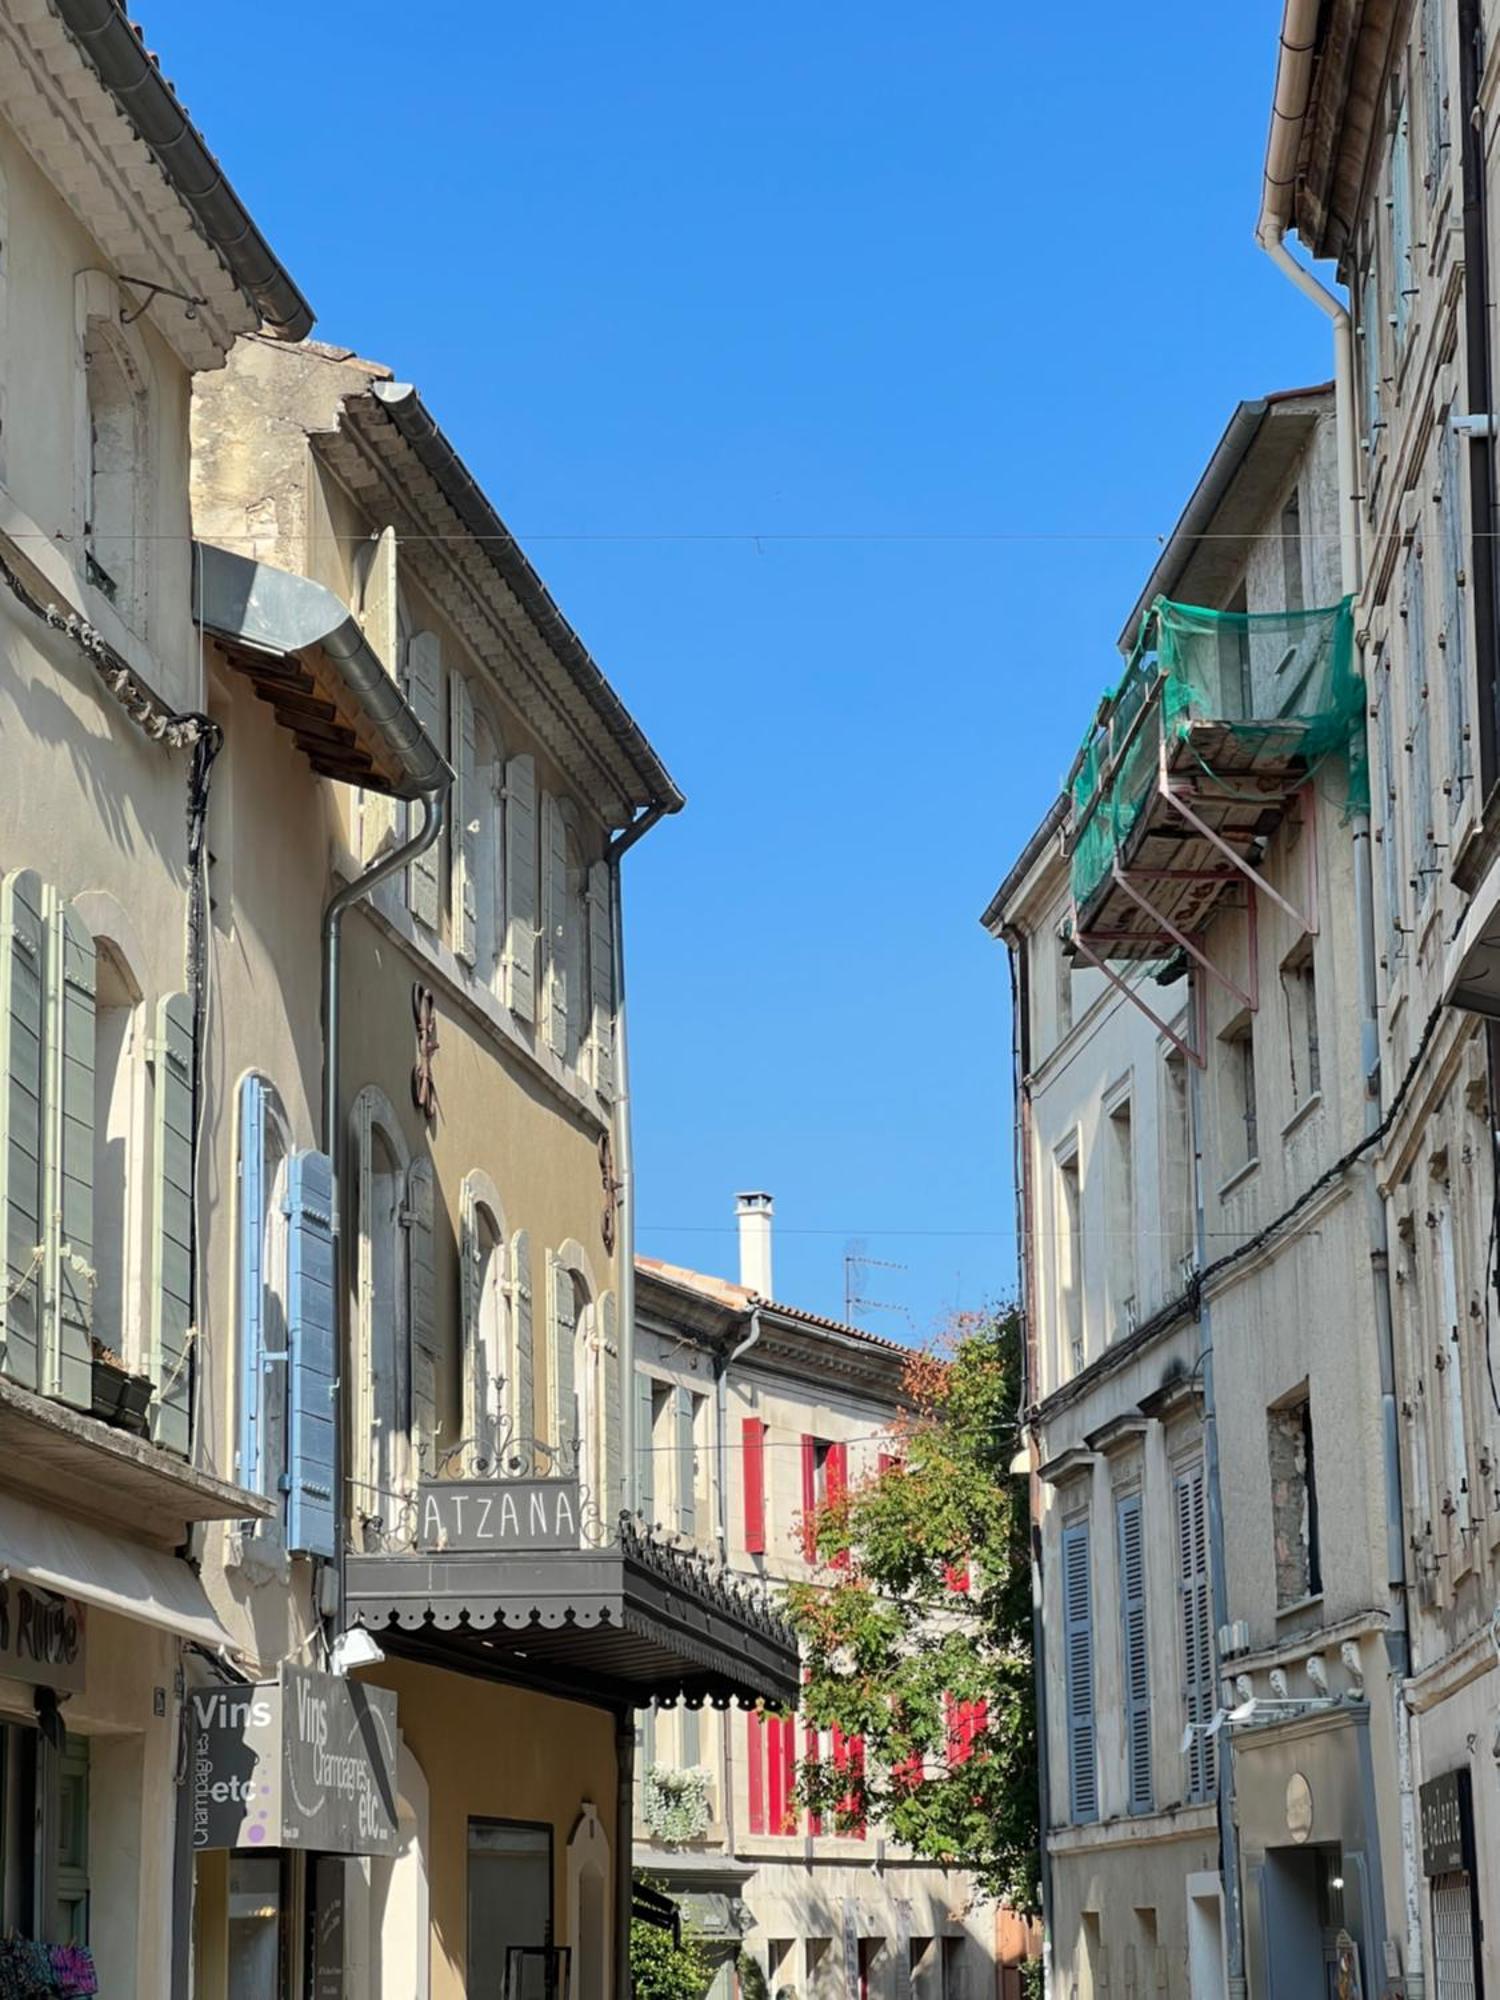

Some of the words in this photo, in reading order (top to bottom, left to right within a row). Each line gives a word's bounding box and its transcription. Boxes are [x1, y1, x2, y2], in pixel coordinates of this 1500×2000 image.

[424, 1491, 575, 1539] ATZANA
[193, 1694, 272, 1729] Vins
[297, 1675, 328, 1745] Vins
[210, 1775, 257, 1802] etc
[313, 1742, 367, 1801] Champagnes
